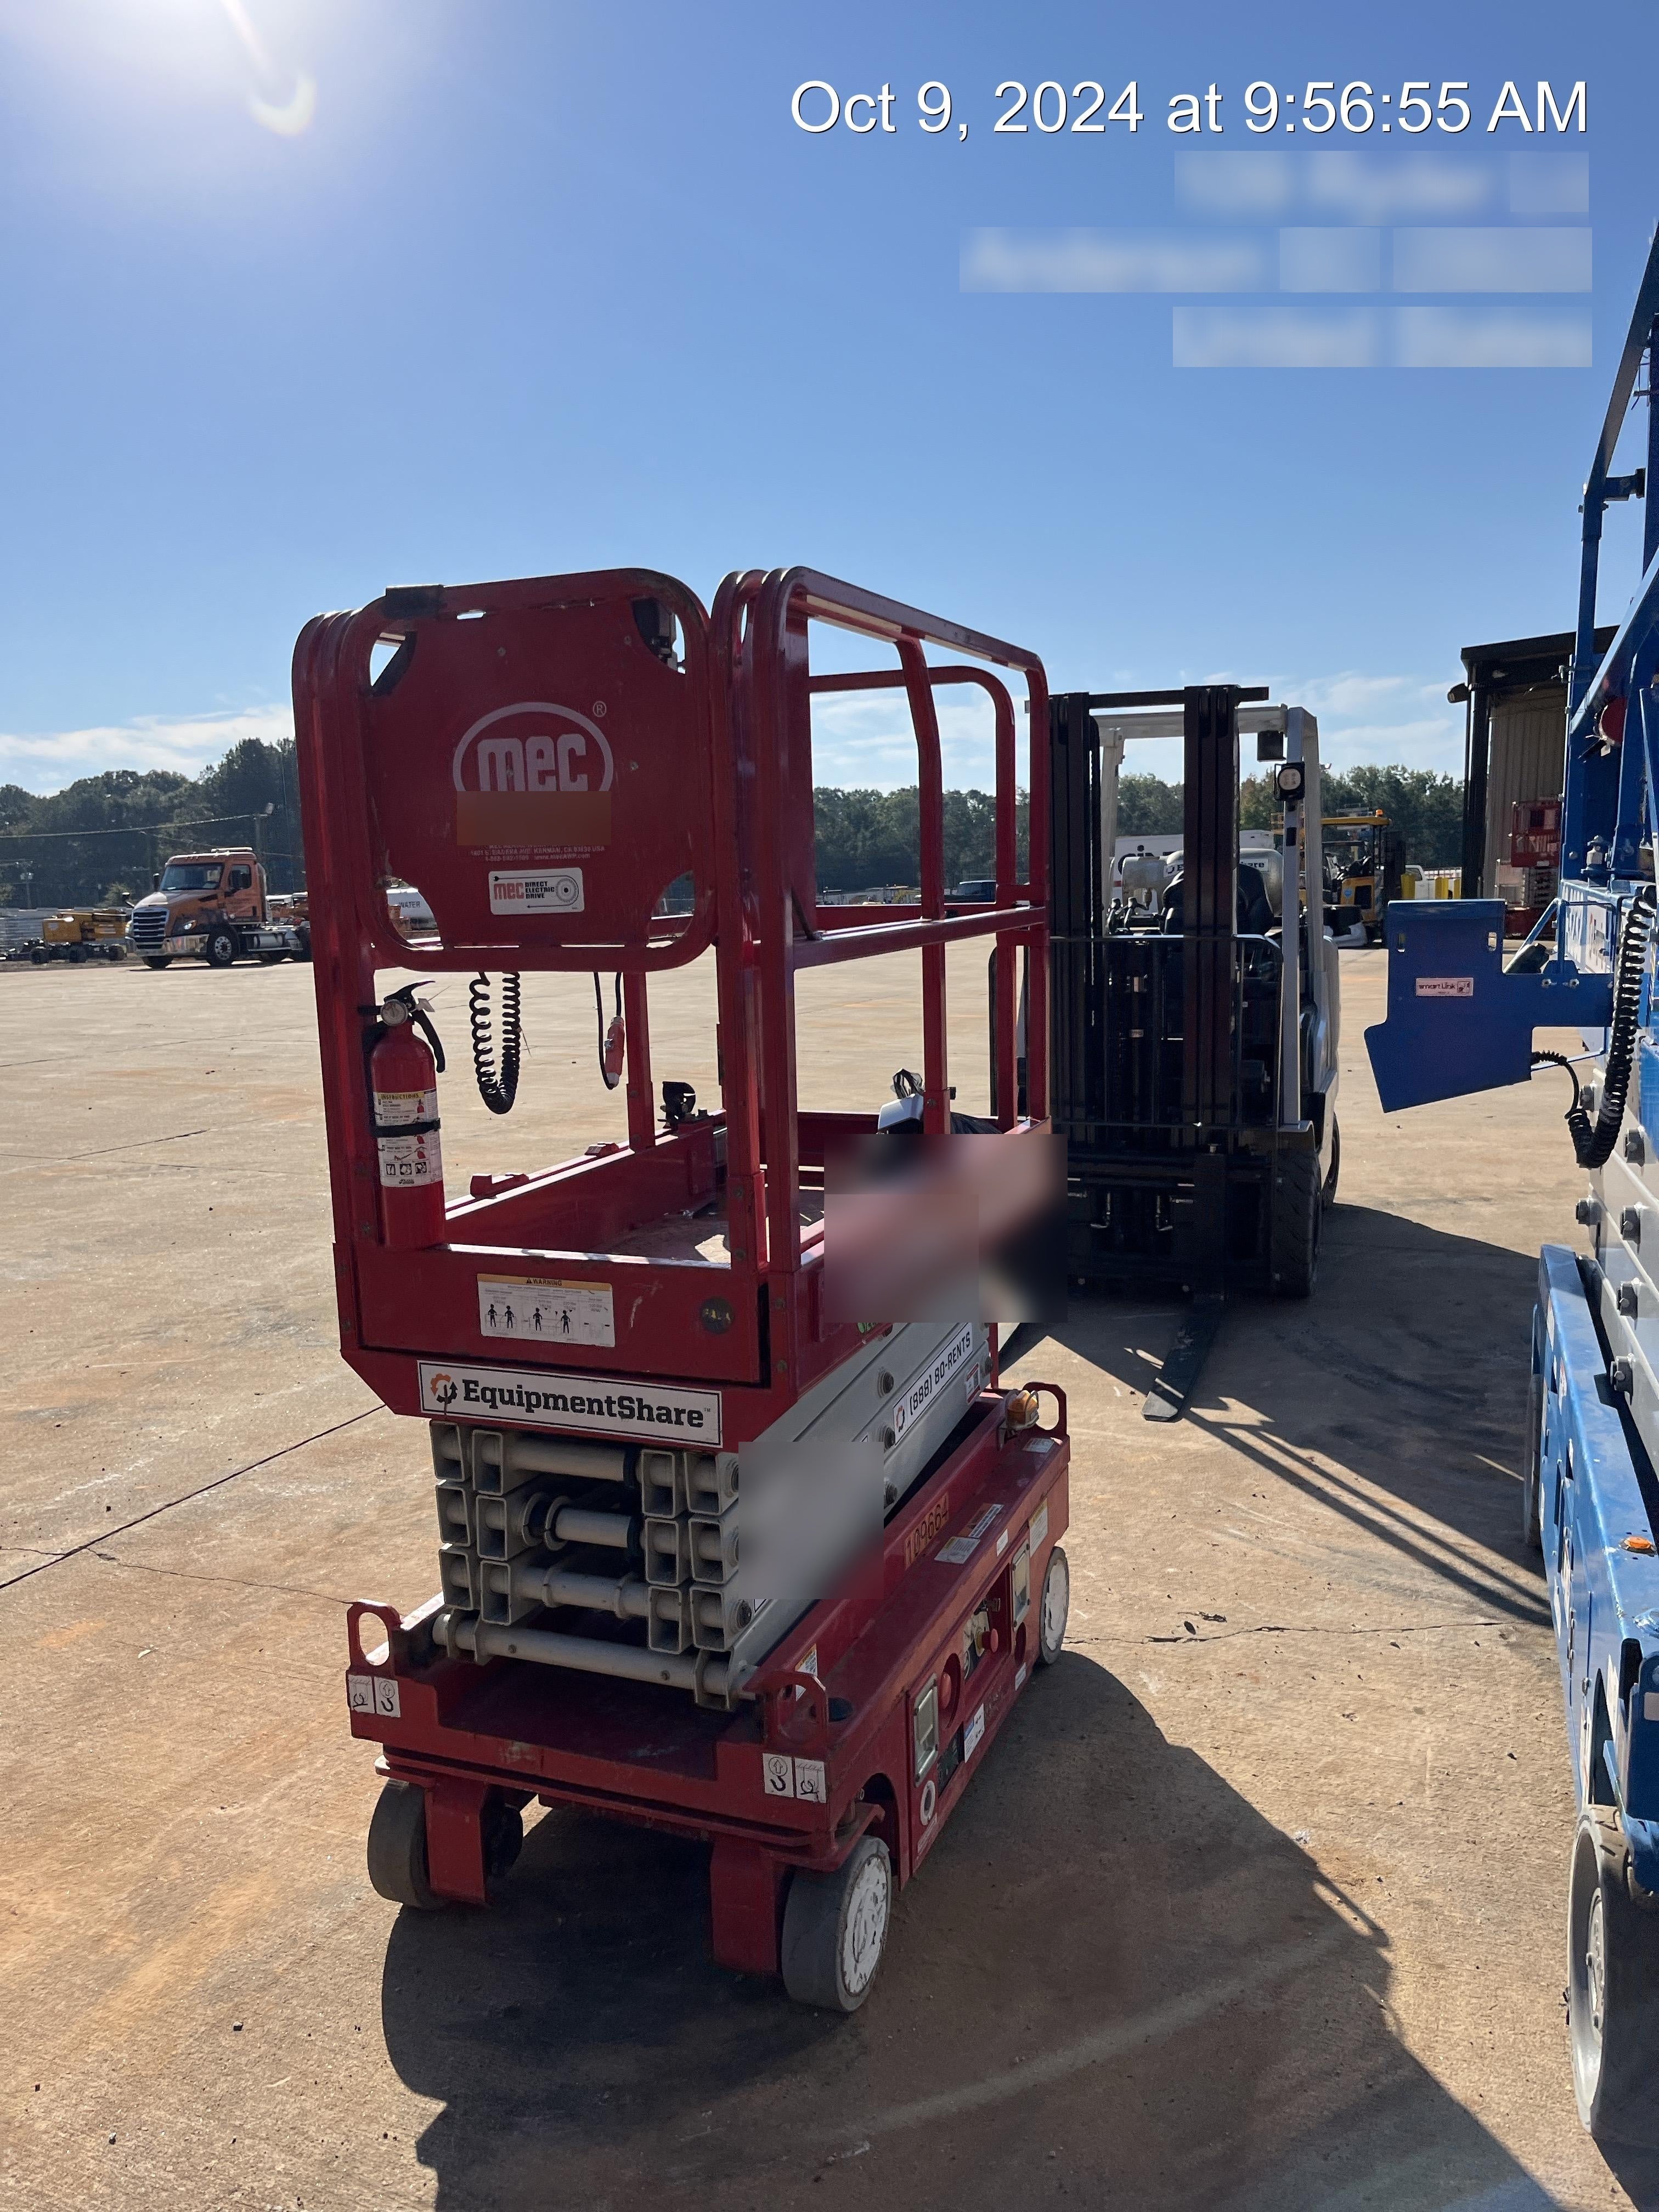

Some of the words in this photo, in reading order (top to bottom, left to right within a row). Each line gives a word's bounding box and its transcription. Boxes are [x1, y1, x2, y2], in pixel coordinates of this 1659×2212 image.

[462, 1379, 704, 1428] EquipmentShare
[910, 1374, 932, 1415] (888)
[934, 1331, 970, 1385] 80-RENTS
